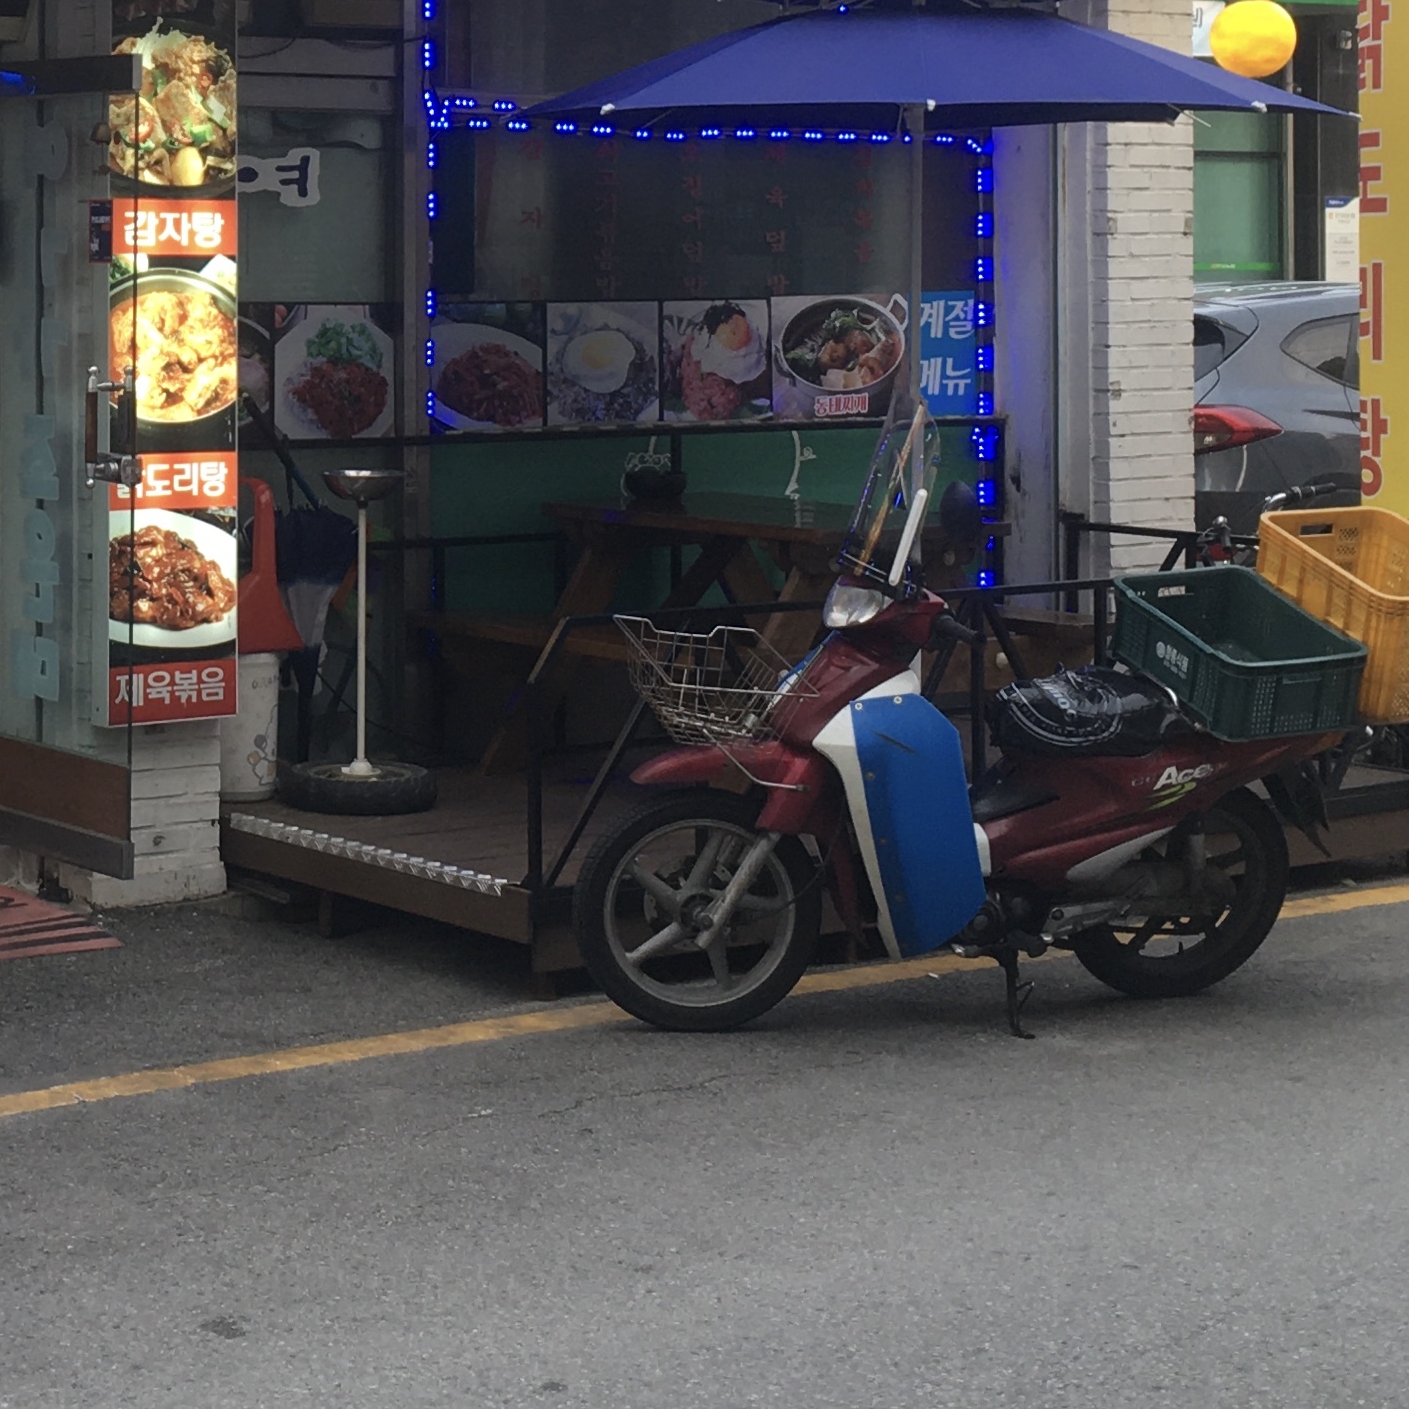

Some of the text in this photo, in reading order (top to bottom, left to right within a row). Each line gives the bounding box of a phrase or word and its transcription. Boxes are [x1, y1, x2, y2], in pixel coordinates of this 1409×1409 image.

[123, 211, 225, 249] 감자탕
[919, 298, 975, 340] 계절
[114, 666, 226, 708] 제육볶음
